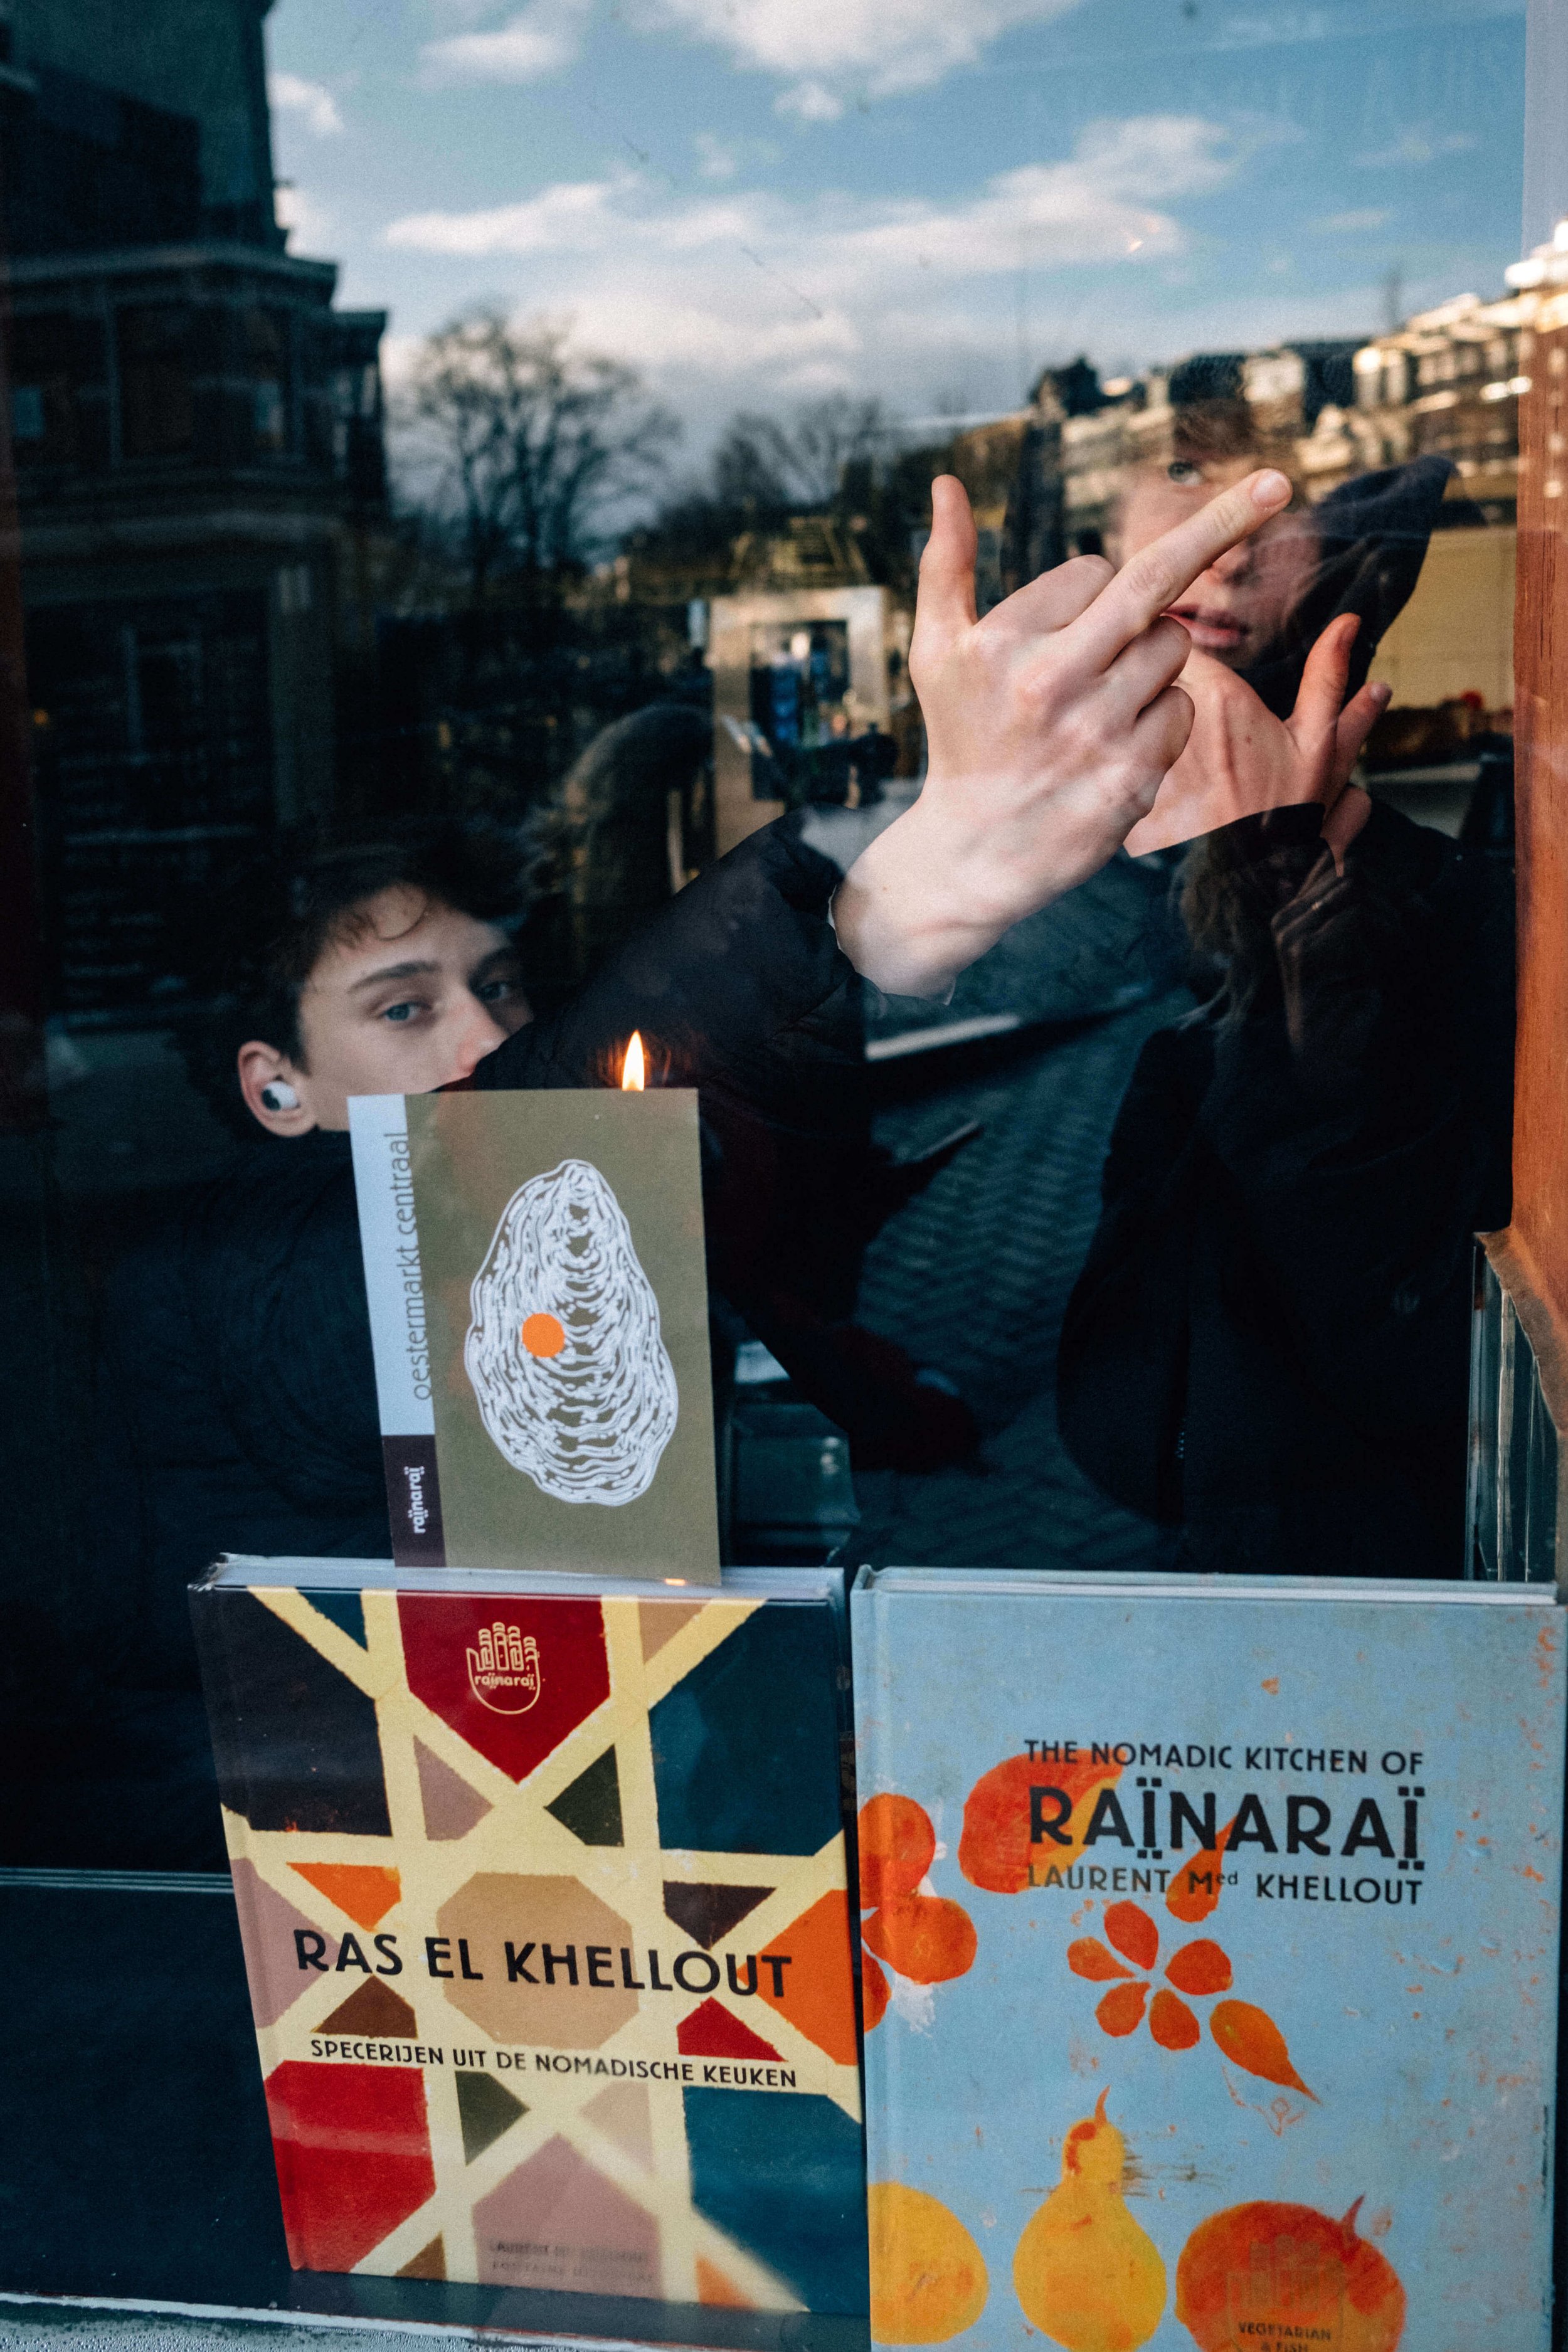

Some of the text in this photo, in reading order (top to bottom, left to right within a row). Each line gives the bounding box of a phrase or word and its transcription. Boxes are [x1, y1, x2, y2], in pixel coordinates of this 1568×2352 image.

[384, 1132, 432, 1401] oestermarkt centraal
[1024, 1739, 1423, 1775] THE NOMADIC KITCHEN OF
[1029, 1777, 1426, 1871] RAÏNARAÏ
[1027, 1864, 1171, 1893] LAURENT
[1256, 1873, 1422, 1905] KHELLOUT
[293, 1928, 792, 1997] RAS EL KHELLOUT
[310, 2039, 797, 2087] SPECERIJEN UIT DE NOMADISCHE KEUKEN
[1237, 2321, 1332, 2341] VEGETARIAN
